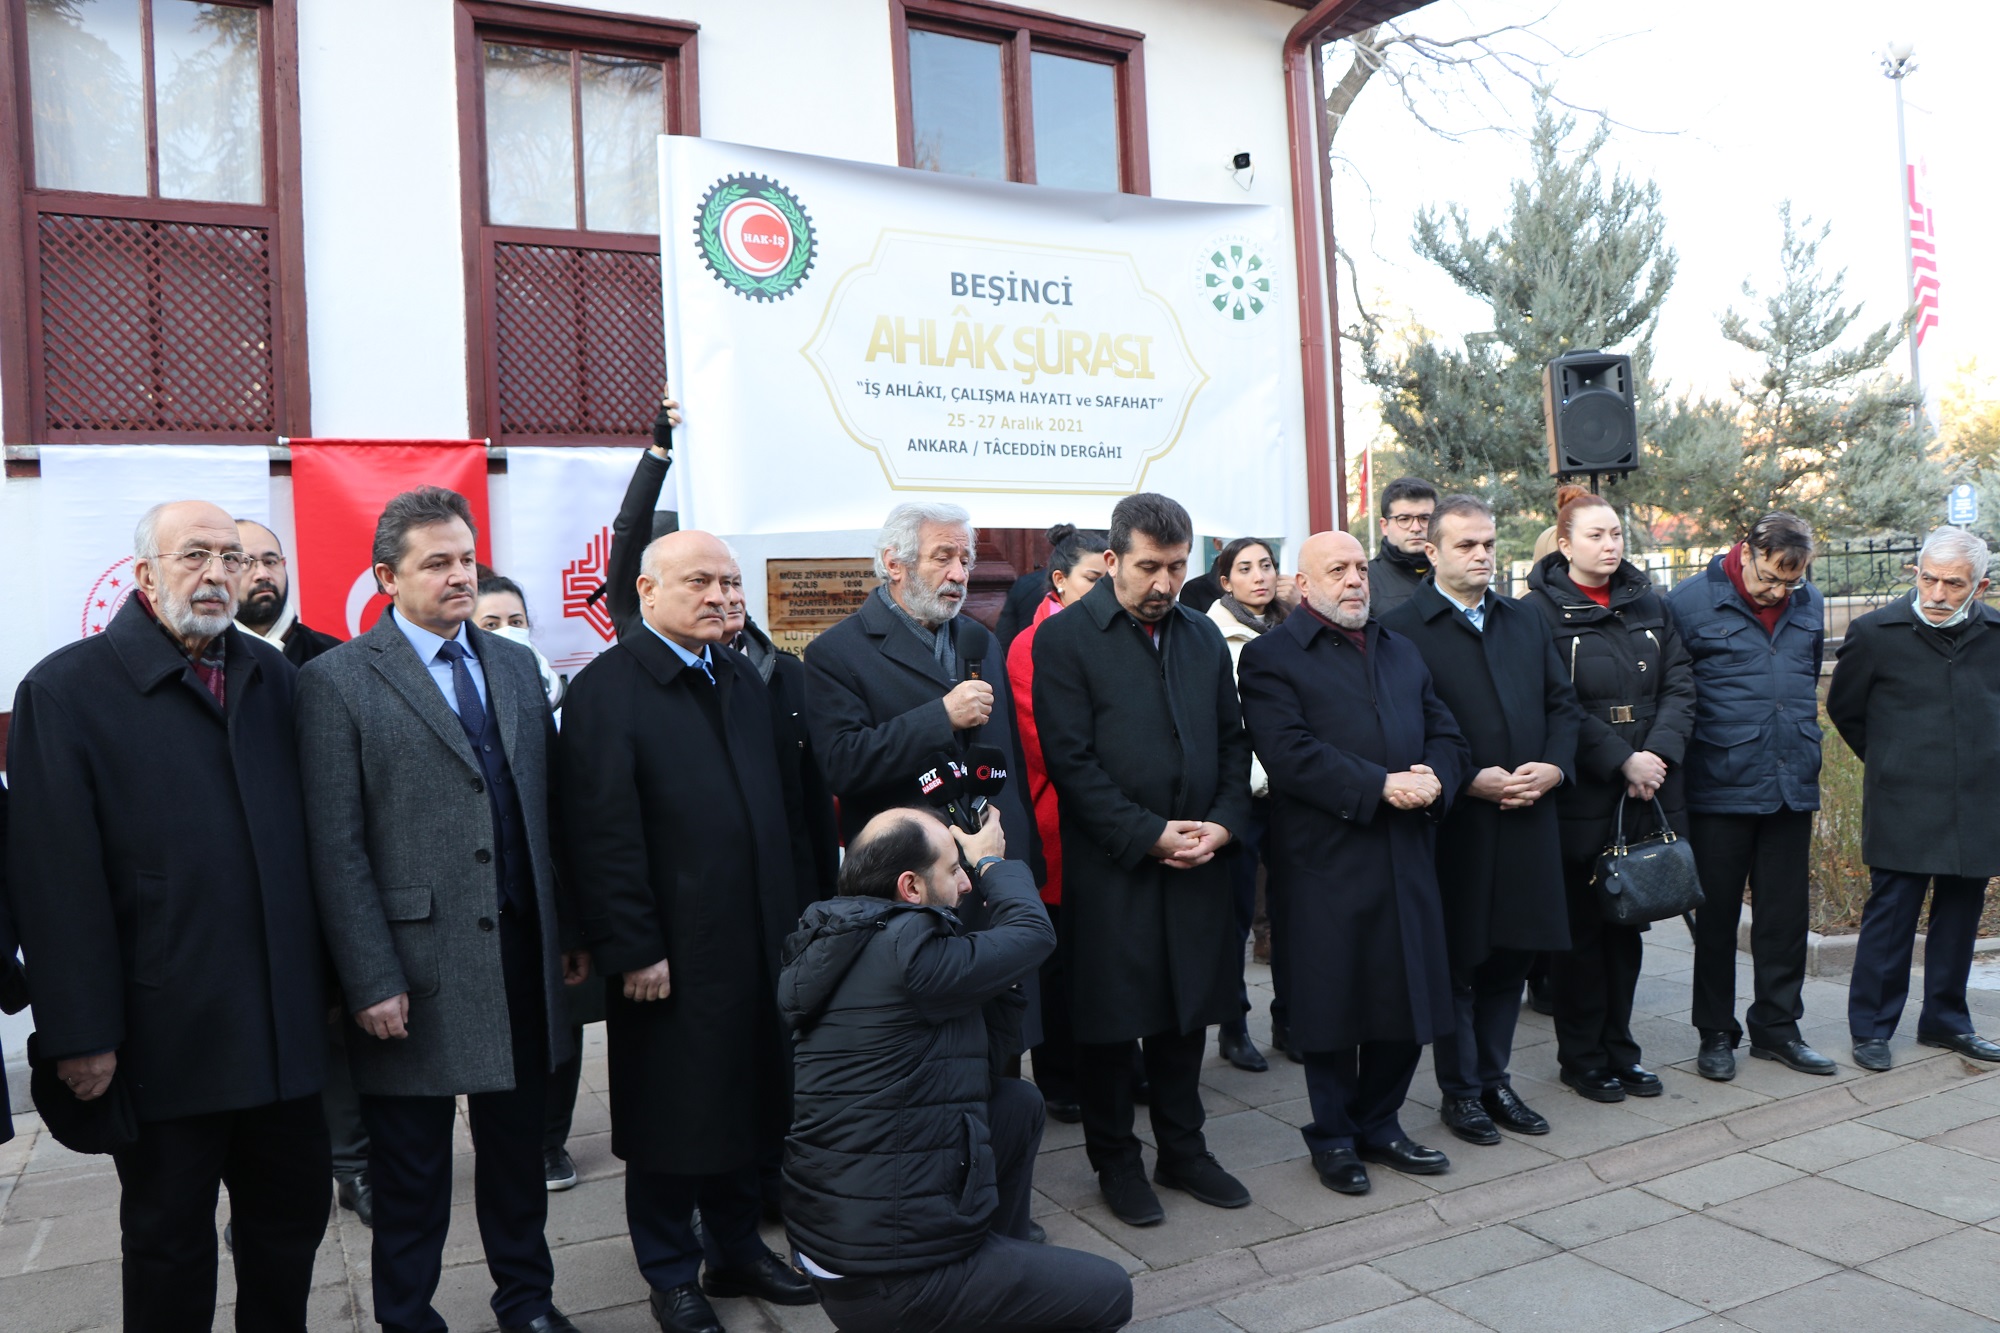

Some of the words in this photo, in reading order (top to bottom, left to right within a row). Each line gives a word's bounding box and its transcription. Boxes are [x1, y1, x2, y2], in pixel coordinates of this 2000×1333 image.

[950, 270, 1073, 306] BEŞİNCİ
[864, 304, 1008, 371] AHLÂK
[1012, 311, 1155, 385] ŞÛRASI
[885, 381, 946, 402] AHLÂKI,
[951, 387, 1016, 405] ÇALIŞMA
[1020, 391, 1072, 406] HAYATI
[1076, 397, 1092, 406] ve
[947, 413, 966, 427] 25
[978, 415, 995, 428] 27
[1001, 416, 1043, 430] Aralık
[1048, 418, 1083, 432] 2021
[907, 438, 968, 454] ANKARA
[984, 437, 1056, 457] TÂCEDDİN
[1061, 441, 1122, 459] DERGÂHI
[804, 570, 837, 579] ZİYARET
[792, 581, 818, 590] AÇILIŞ
[918, 767, 938, 787] TRT
[990, 768, 1007, 779] İHA
[921, 778, 943, 795] HABER
